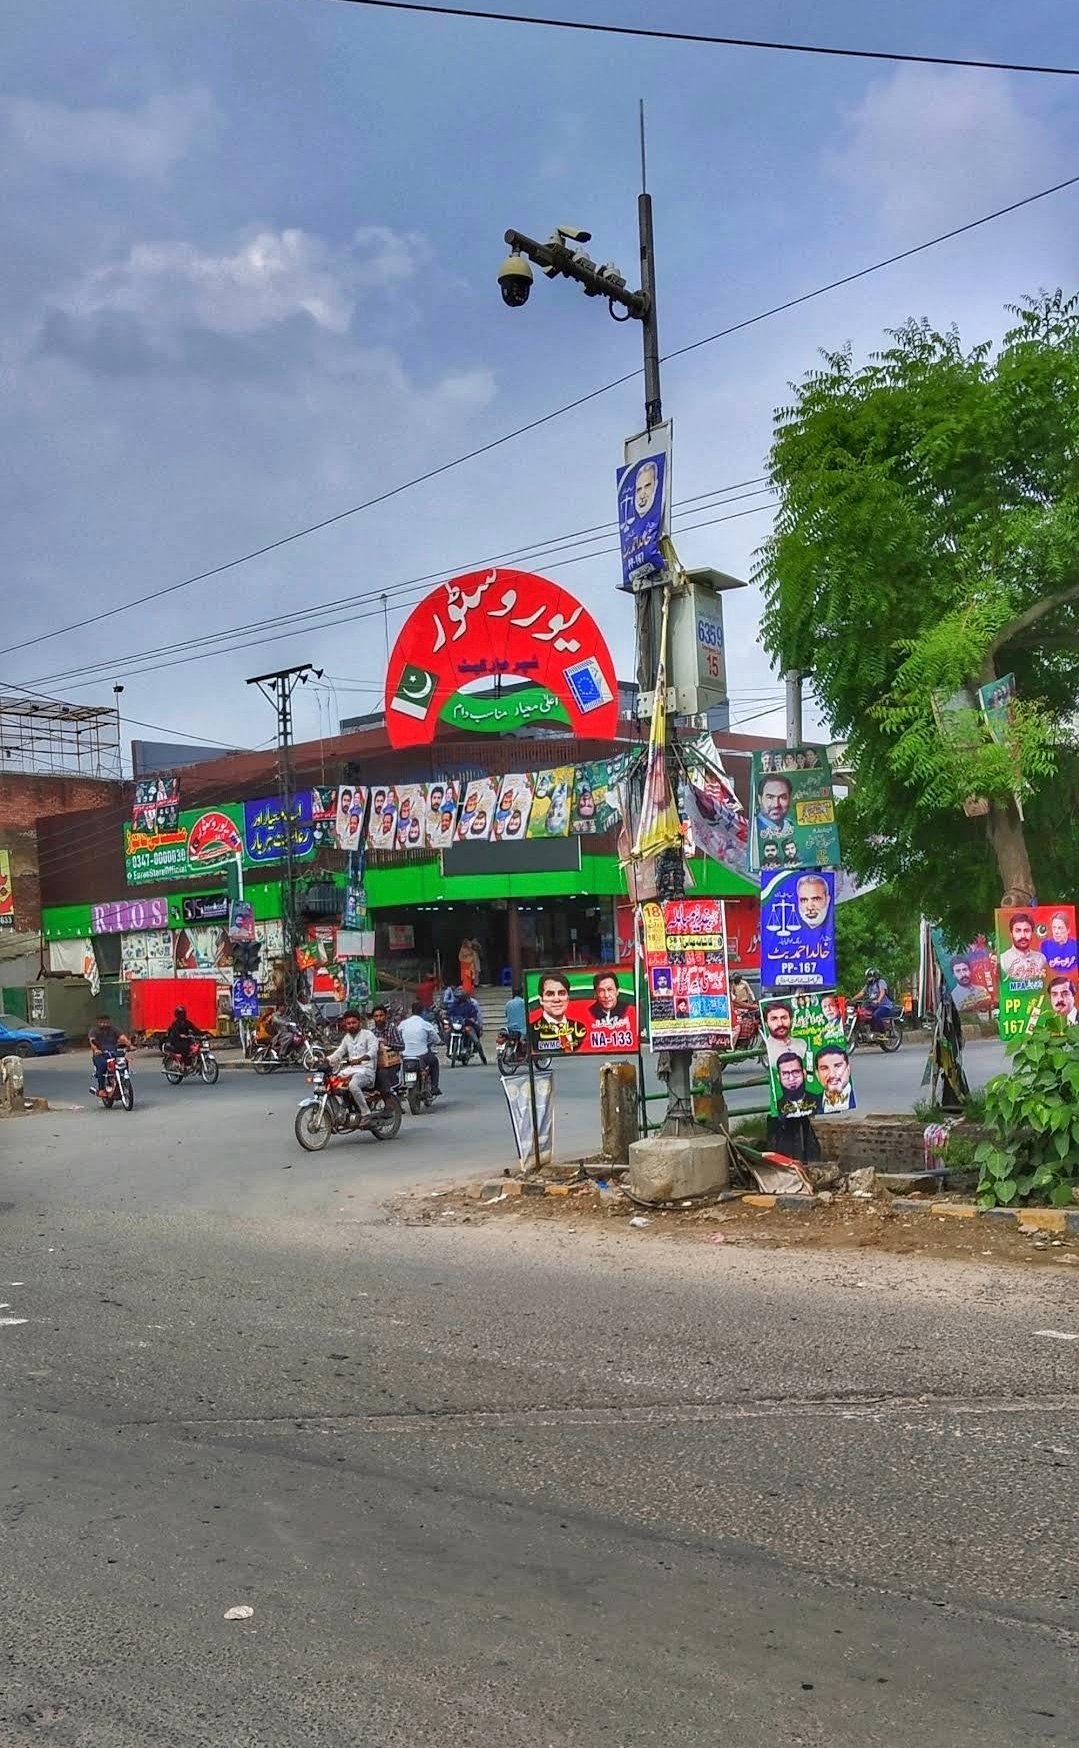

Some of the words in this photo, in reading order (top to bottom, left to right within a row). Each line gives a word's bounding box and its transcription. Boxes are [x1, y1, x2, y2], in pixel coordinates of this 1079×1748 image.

[432, 568, 497, 653] سٹور
[488, 589, 583, 653] یورو
[698, 620, 723, 648] 6359
[706, 655, 719, 677] 15
[453, 703, 470, 719] دام
[471, 704, 507, 723] مناسب
[514, 702, 539, 718] معیار
[94, 900, 163, 931] RIOS
[644, 906, 661, 918] 18
[768, 946, 789, 960] بٹ
[789, 945, 809, 960] احمد
[807, 942, 830, 959] خالد
[781, 962, 817, 974] PP-167
[1005, 998, 1021, 1014] PP
[540, 1020, 587, 1040] عاطف
[1003, 1020, 1025, 1035] 167
[590, 1031, 633, 1047] NA-133
